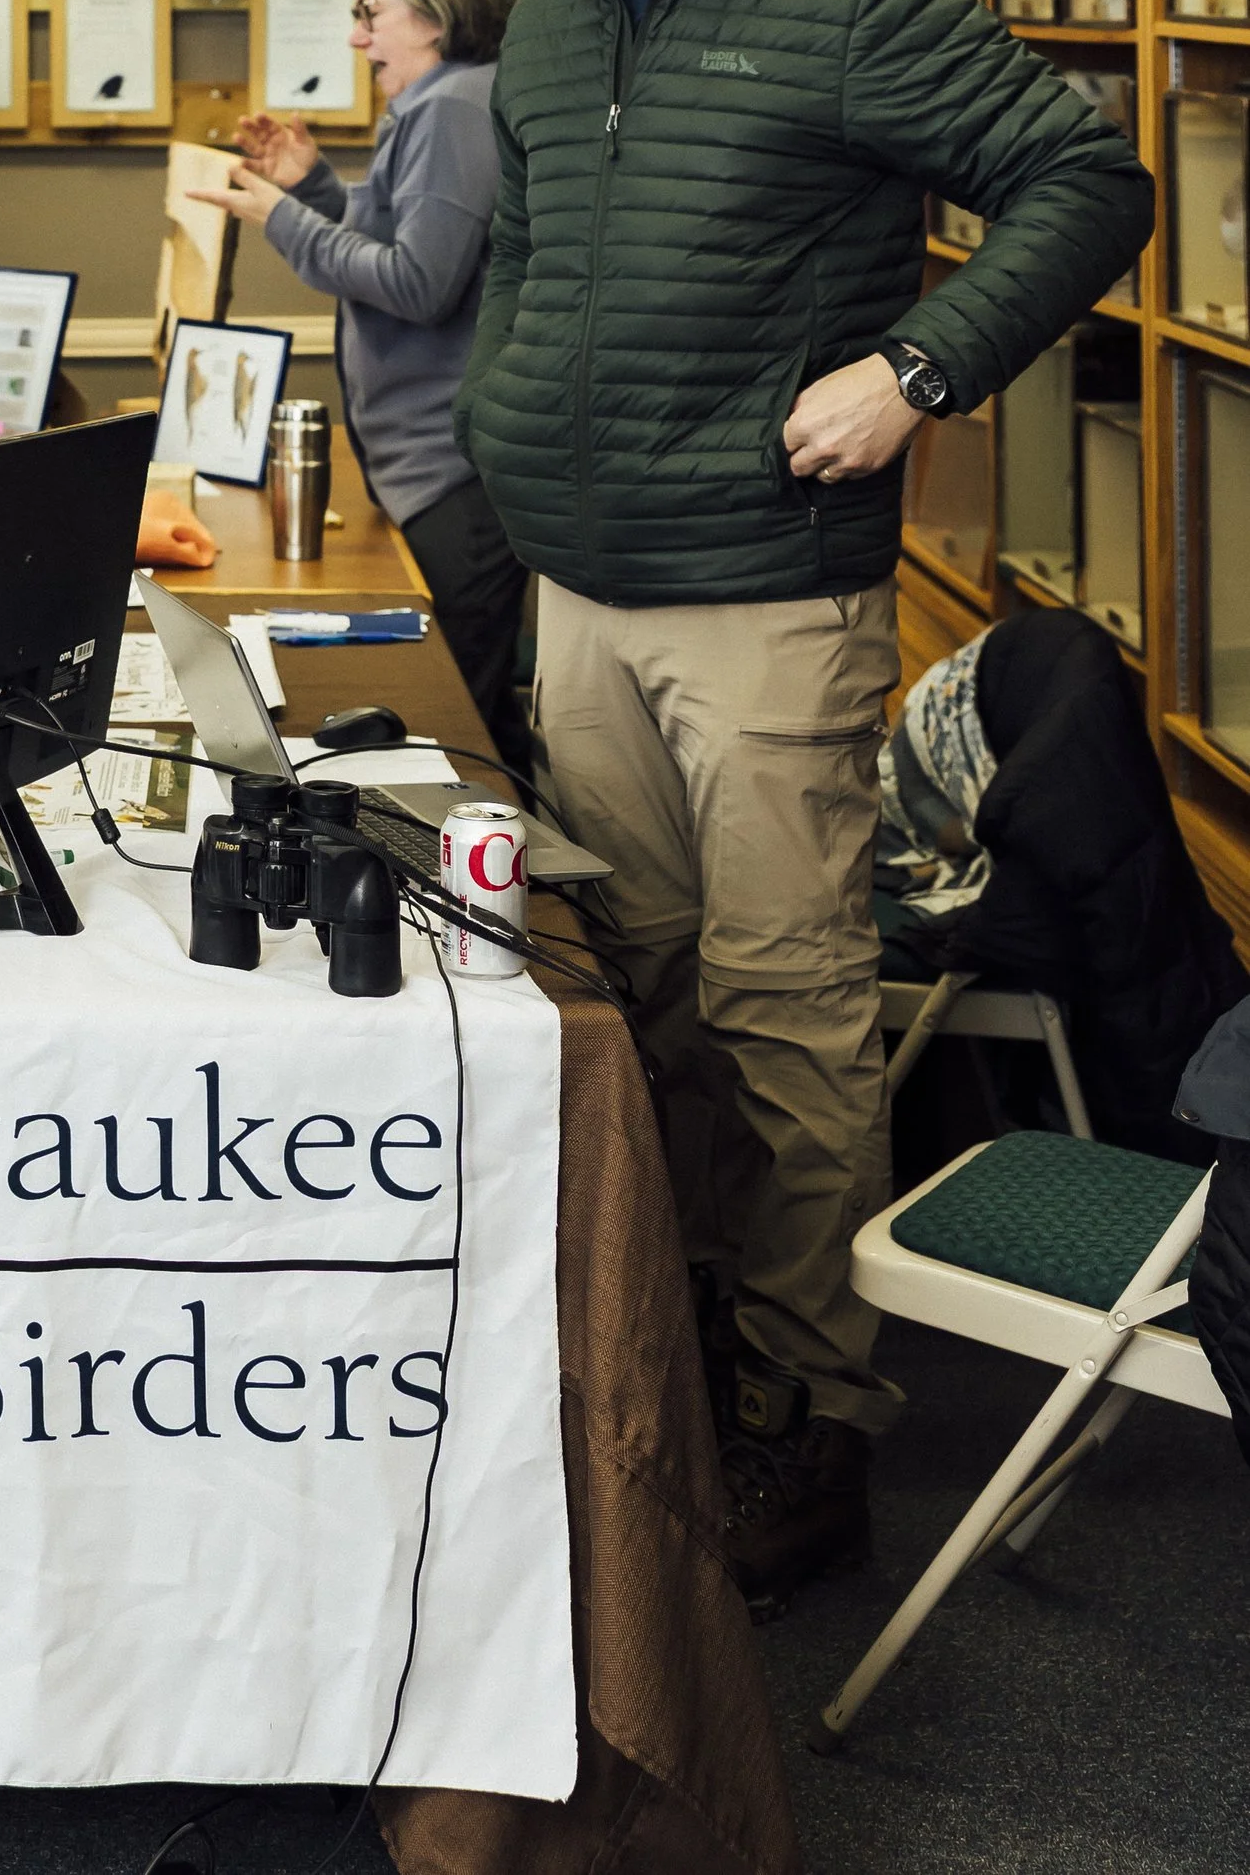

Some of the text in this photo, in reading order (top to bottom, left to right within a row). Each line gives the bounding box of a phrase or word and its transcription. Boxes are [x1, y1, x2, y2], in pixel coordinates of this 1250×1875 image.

[702, 50, 738, 62] EDDIE
[701, 59, 738, 72] BAUER
[214, 840, 241, 852] Nikon
